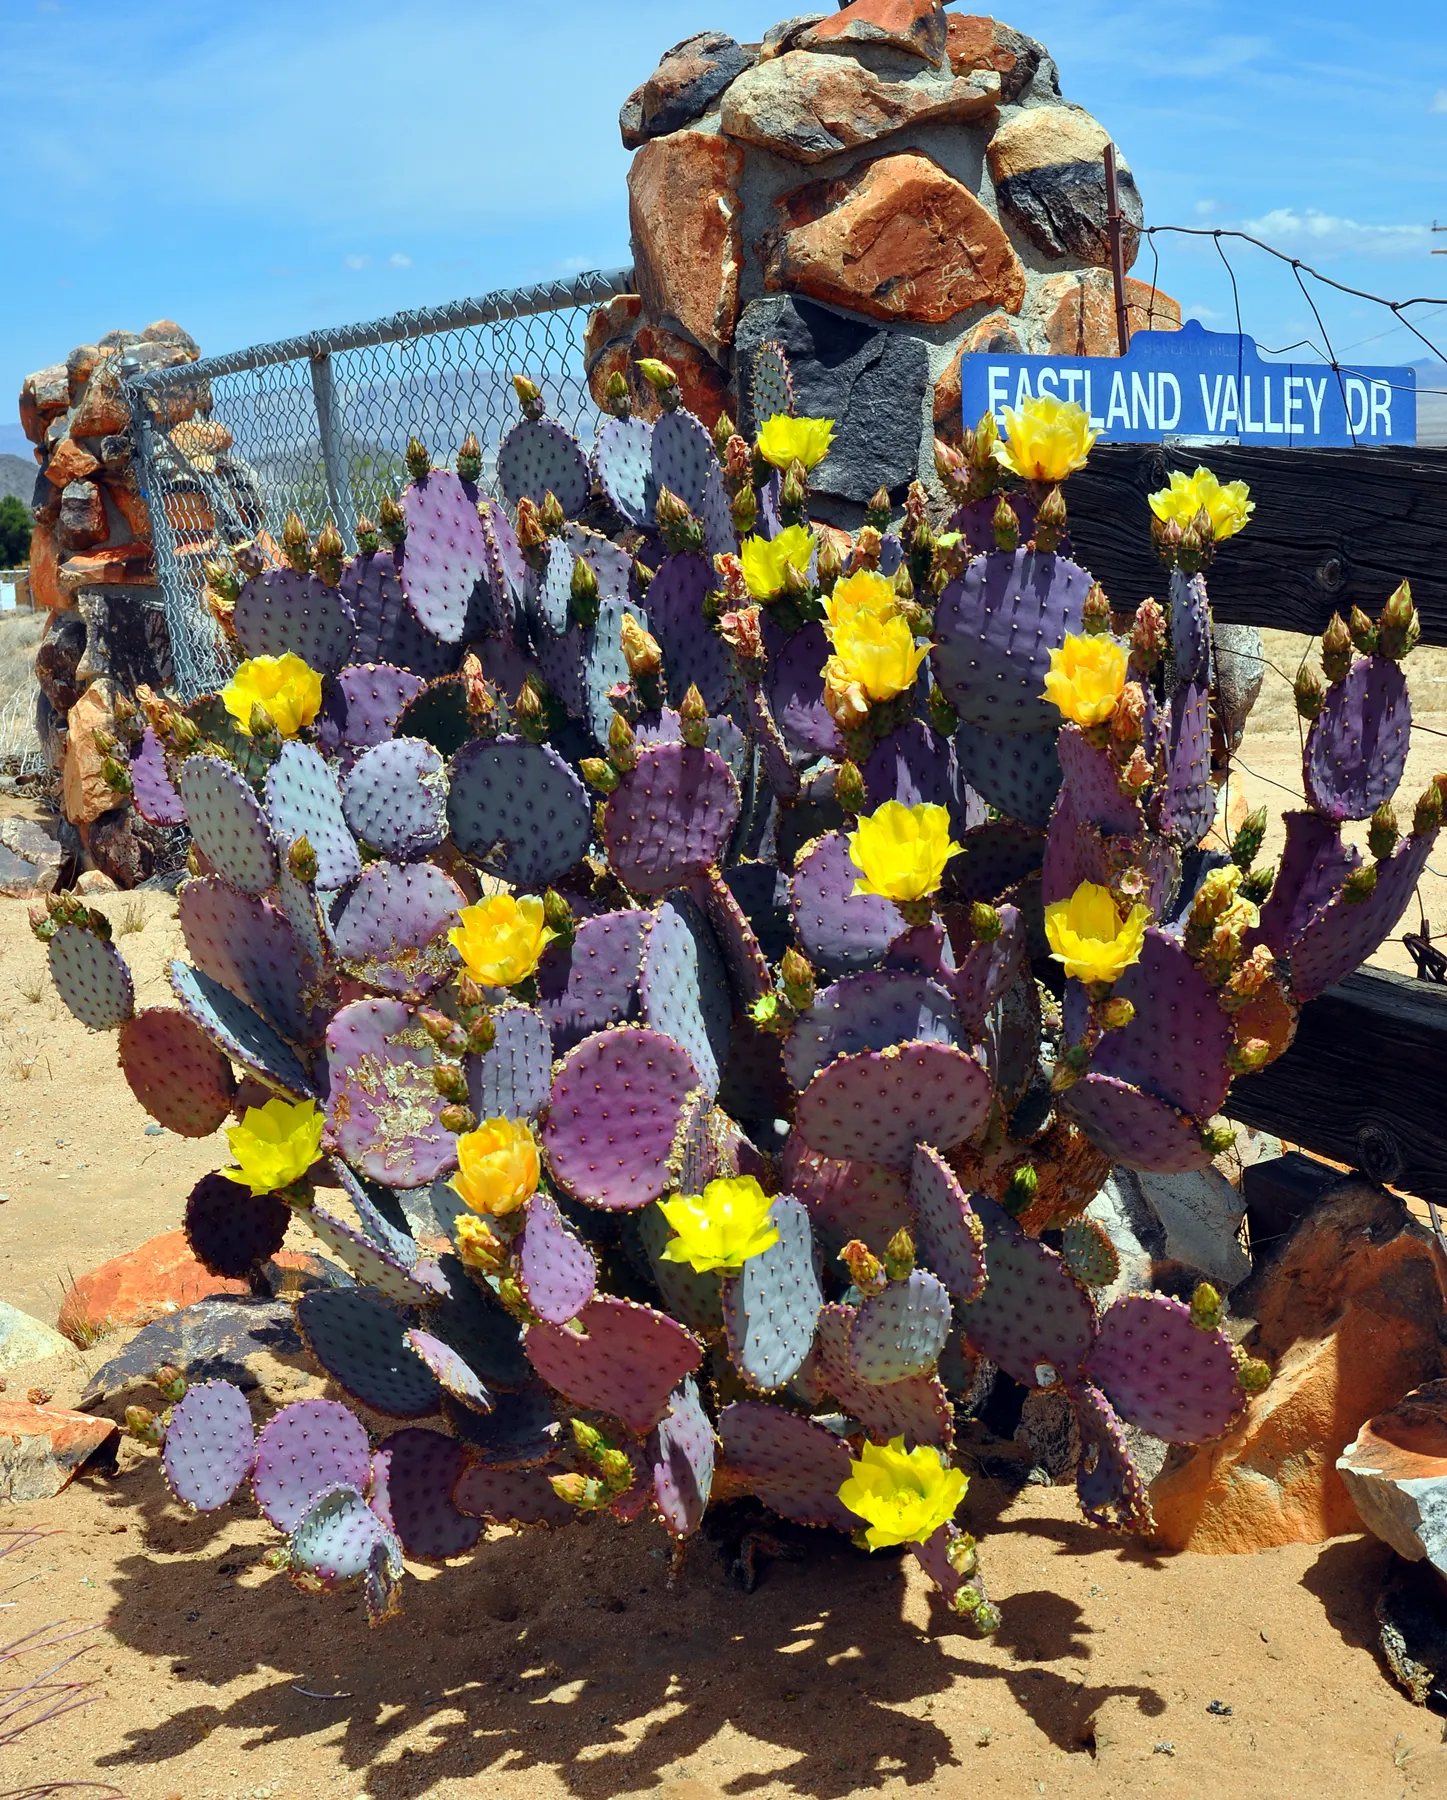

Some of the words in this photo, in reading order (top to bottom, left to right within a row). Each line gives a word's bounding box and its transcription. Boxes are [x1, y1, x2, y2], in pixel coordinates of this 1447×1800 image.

[988, 366, 1181, 431] EASTLAND
[1199, 373, 1328, 435] VALLEY
[1345, 378, 1392, 436] DR
